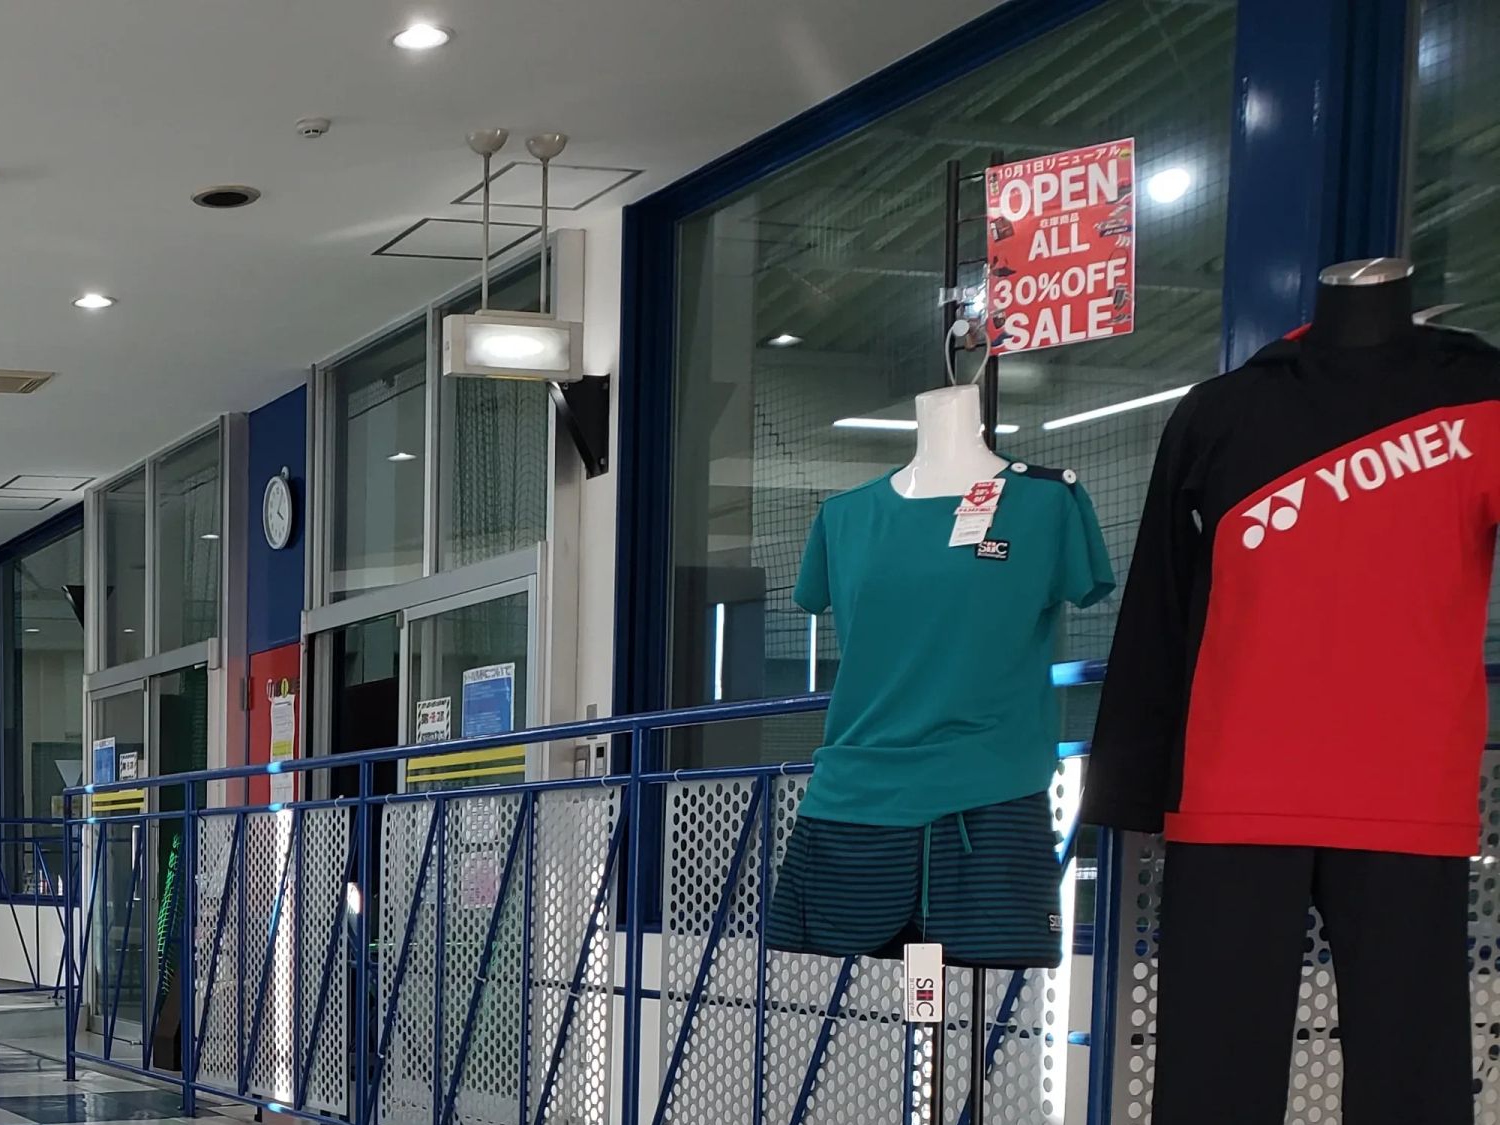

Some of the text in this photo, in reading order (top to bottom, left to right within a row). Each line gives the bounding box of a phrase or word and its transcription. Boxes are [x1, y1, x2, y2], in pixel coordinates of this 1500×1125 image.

[998, 146, 1120, 180] 10月1日リニューアル
[1000, 159, 1118, 222] OPEN
[1028, 223, 1090, 261] ALL
[993, 257, 1127, 309] 30%OFF
[1003, 297, 1114, 350] SALE
[1315, 419, 1473, 502] YONEX
